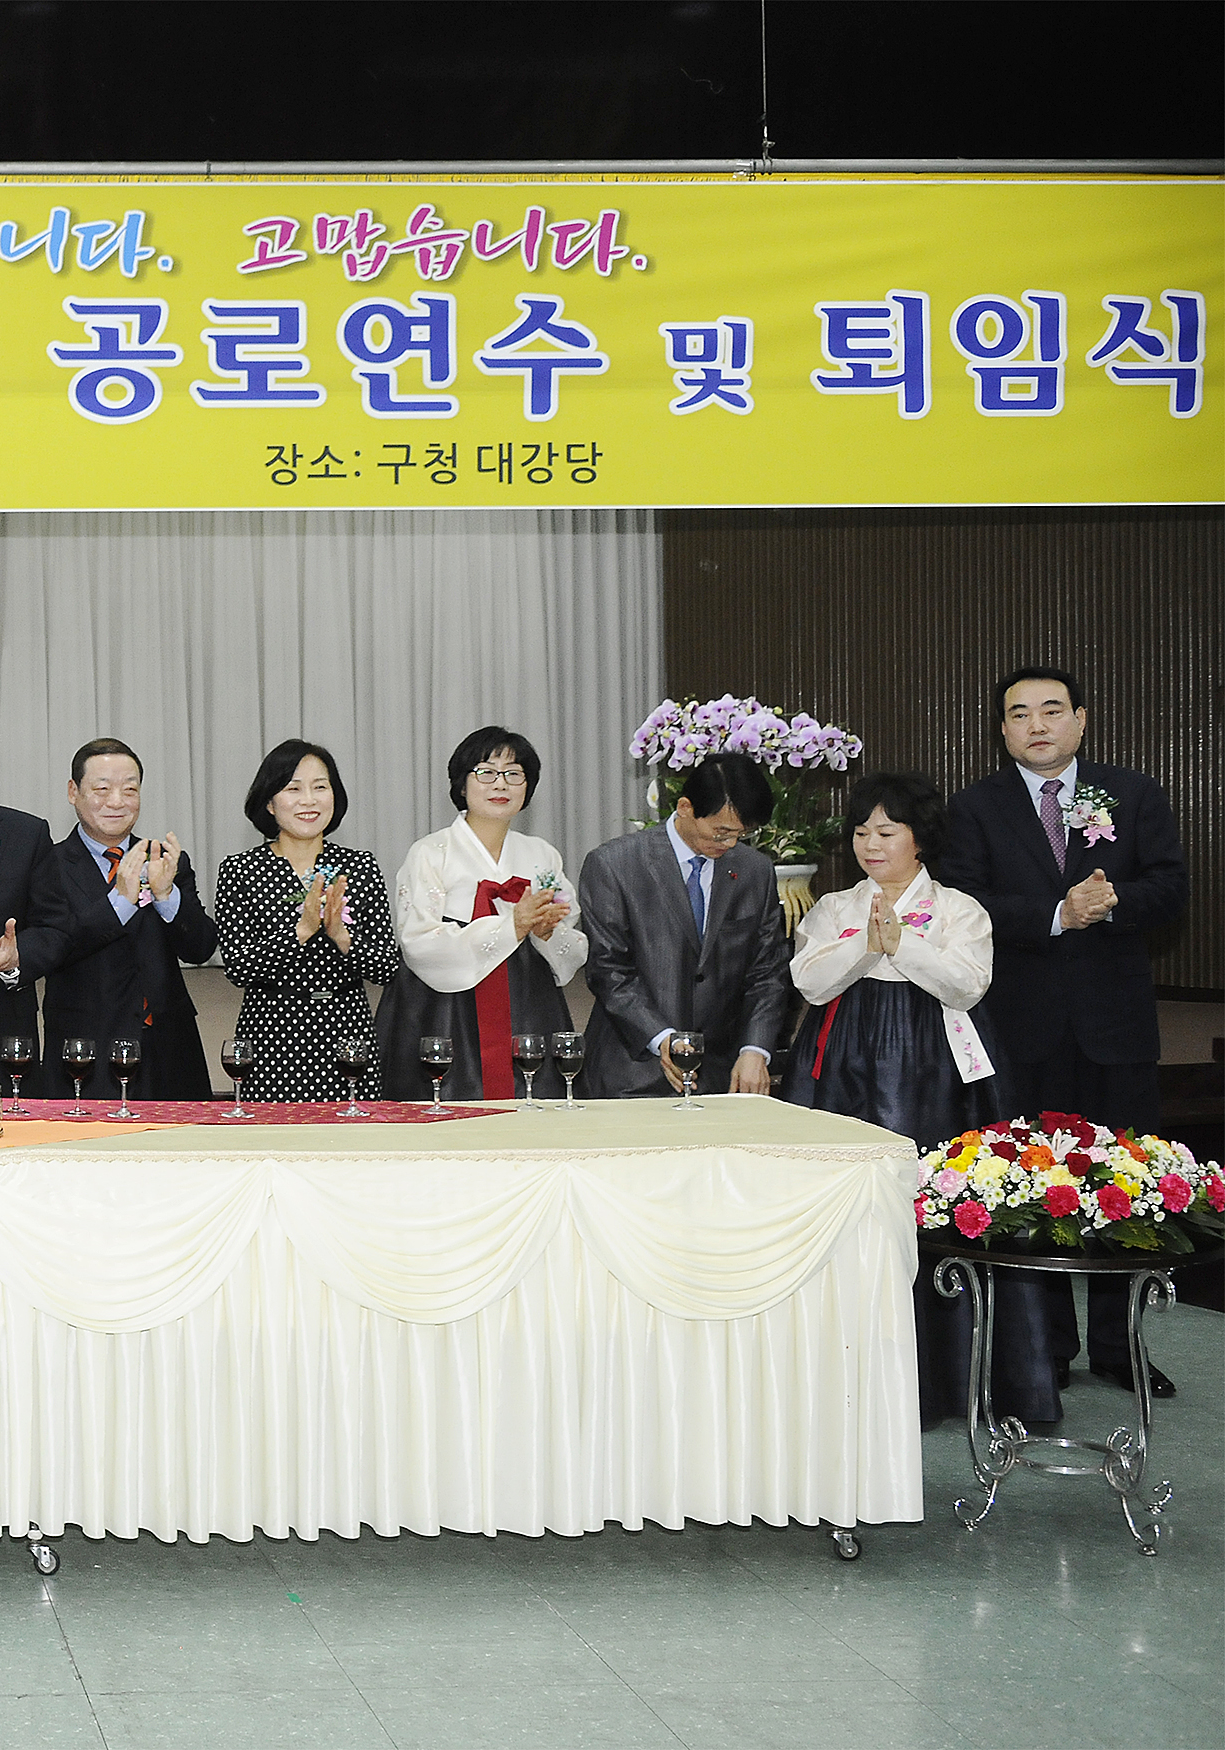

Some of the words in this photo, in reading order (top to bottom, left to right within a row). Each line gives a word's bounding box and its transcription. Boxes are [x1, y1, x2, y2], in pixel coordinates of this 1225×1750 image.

[237, 204, 646, 280] 고맙습니다.
[48, 292, 609, 421] 공로연수
[659, 315, 753, 414] 및
[811, 290, 1205, 417] 퇴임식
[266, 444, 361, 485] 장소:
[378, 443, 457, 485] 구청
[478, 442, 603, 485] 대강당
